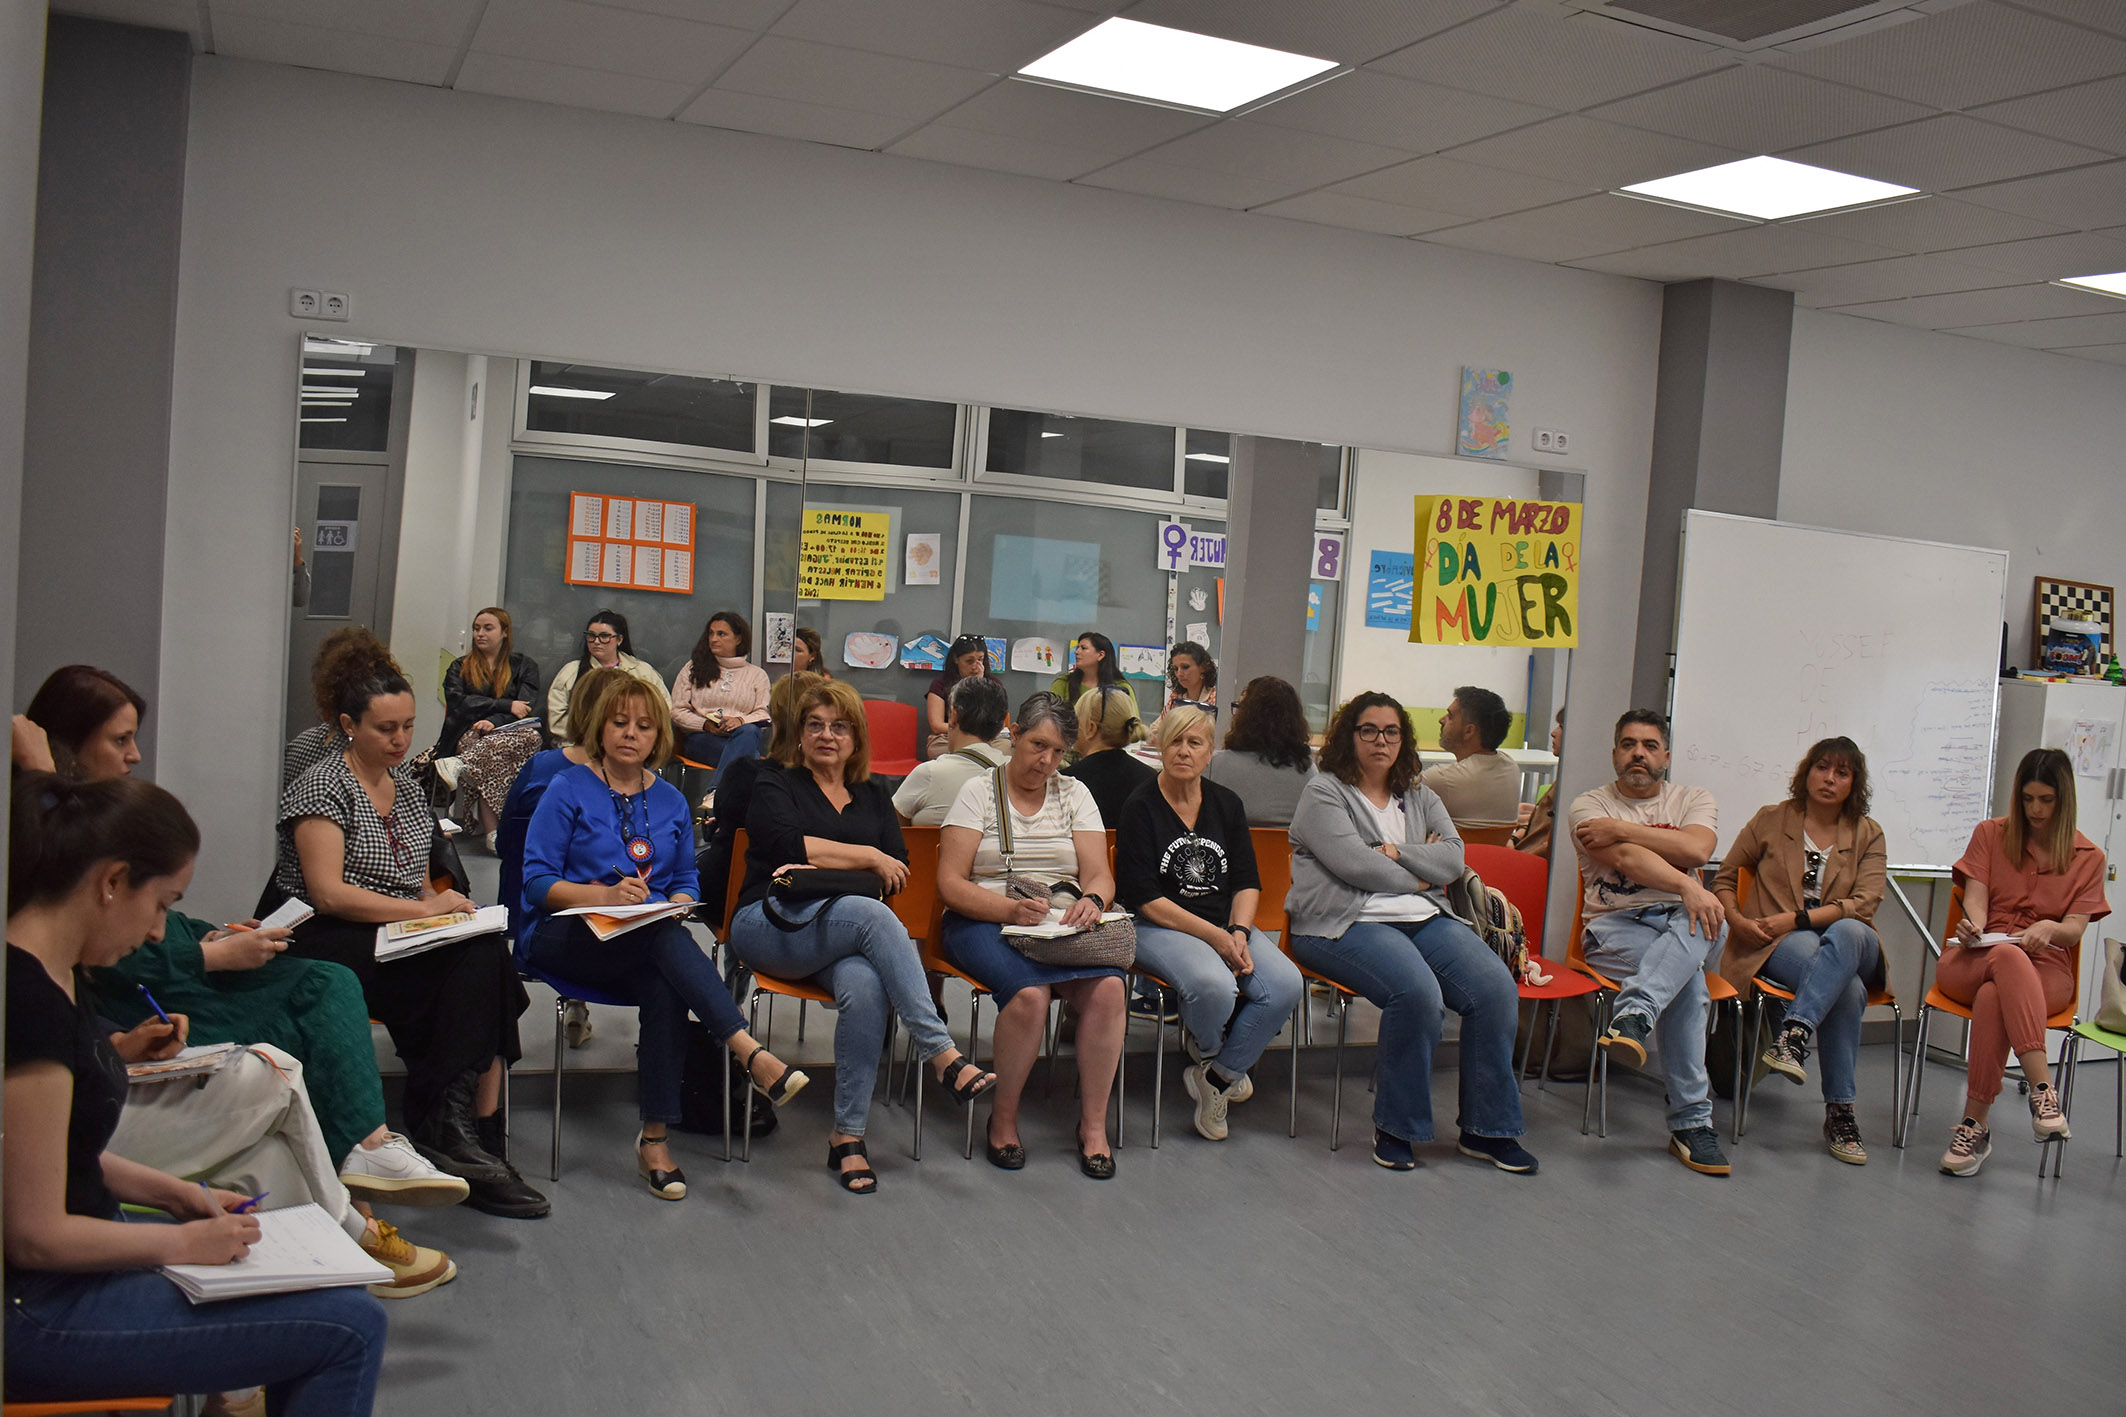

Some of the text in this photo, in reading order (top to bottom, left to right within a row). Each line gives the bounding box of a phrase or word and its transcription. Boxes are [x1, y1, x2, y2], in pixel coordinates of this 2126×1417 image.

[1436, 499, 1570, 536] 8 DE MARZO
[1438, 532, 1559, 586] DÍA DE LA
[1436, 572, 1572, 642] MUJER
[1160, 851, 1171, 875] THE
[1220, 857, 1229, 874] ON
